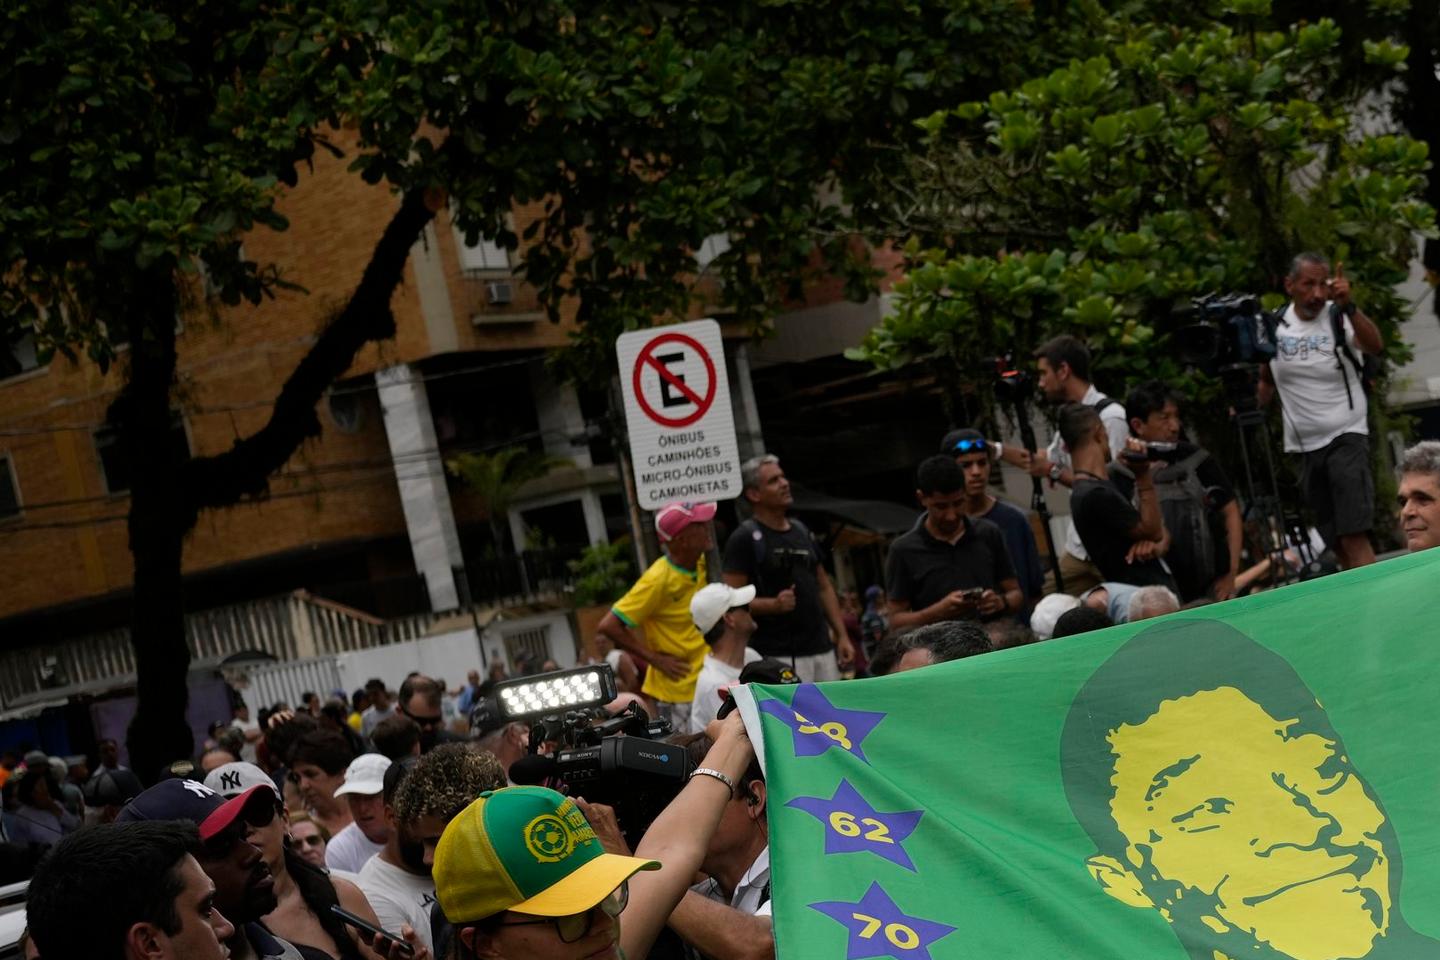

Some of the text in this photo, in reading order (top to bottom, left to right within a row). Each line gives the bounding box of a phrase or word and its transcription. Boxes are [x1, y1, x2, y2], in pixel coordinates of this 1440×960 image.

[657, 352, 692, 407] E
[658, 430, 705, 448] ÔNIBUS
[648, 446, 721, 467] CAMINHÕES
[642, 461, 732, 485] MICRO-ÔNIBUS
[650, 480, 729, 501] CAMIONETAS
[829, 811, 895, 844] 62
[852, 912, 920, 950] 70
